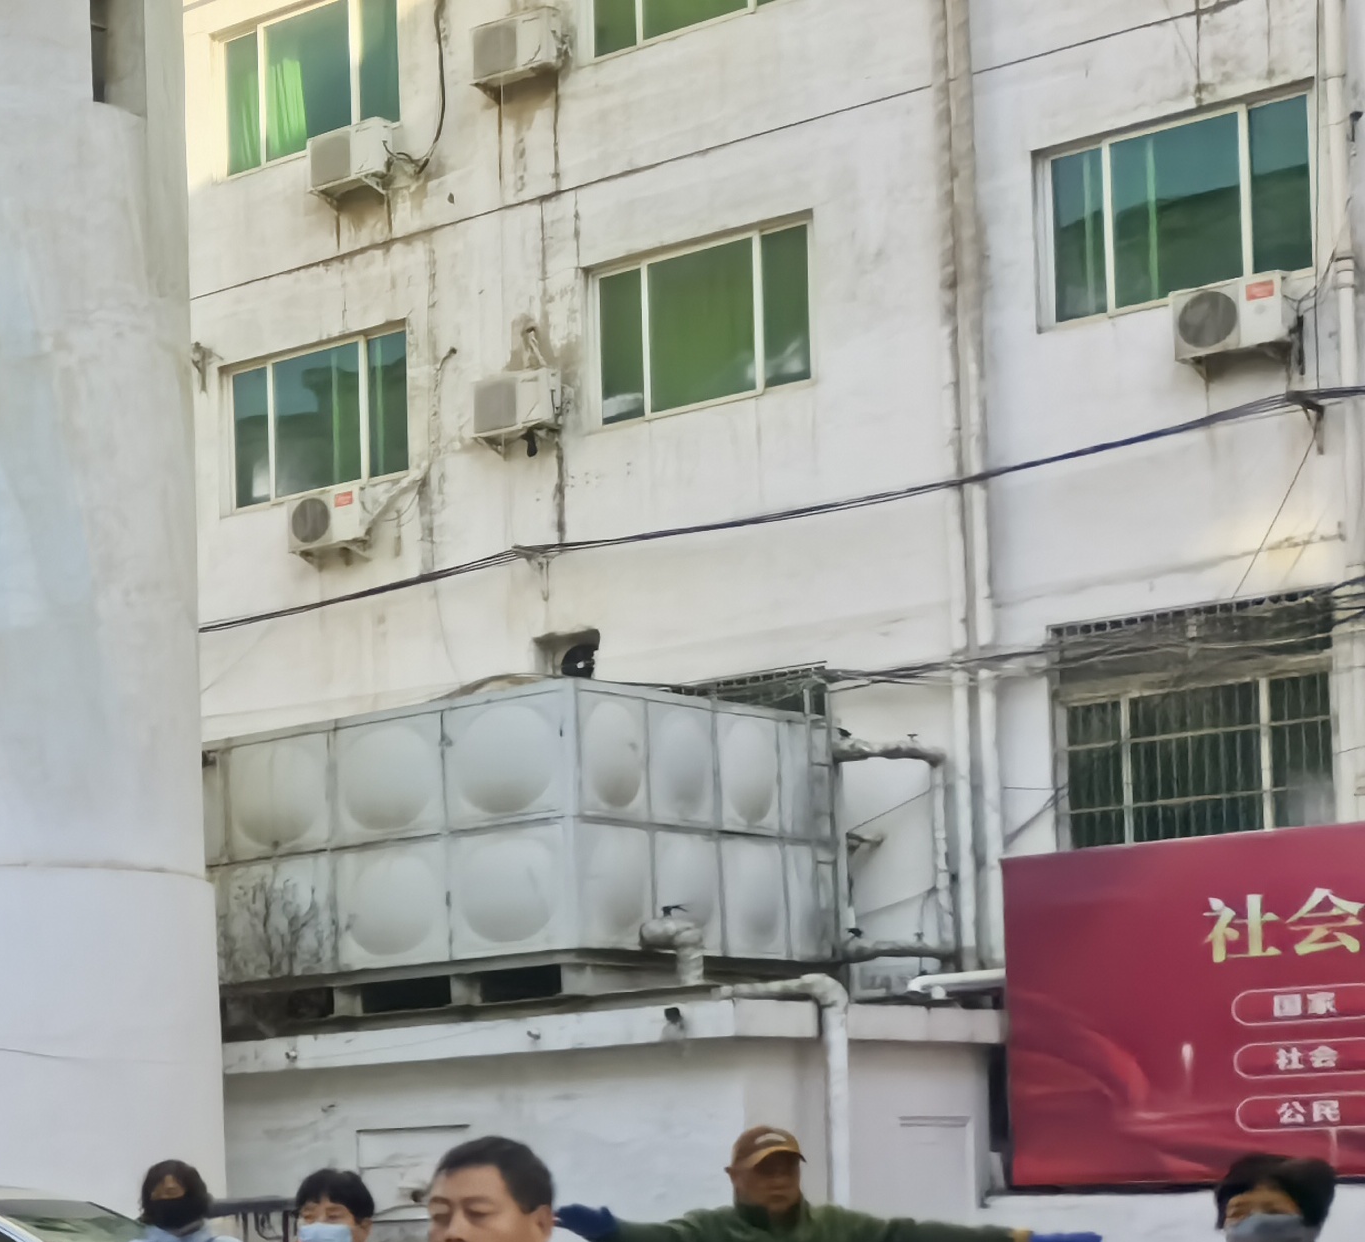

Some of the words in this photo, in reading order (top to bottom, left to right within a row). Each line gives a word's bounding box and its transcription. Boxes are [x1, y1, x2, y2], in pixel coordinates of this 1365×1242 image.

[1201, 887, 1365, 964] 社会
[1276, 1045, 1338, 1071] 社会
[1277, 1100, 1341, 1125] 公民
